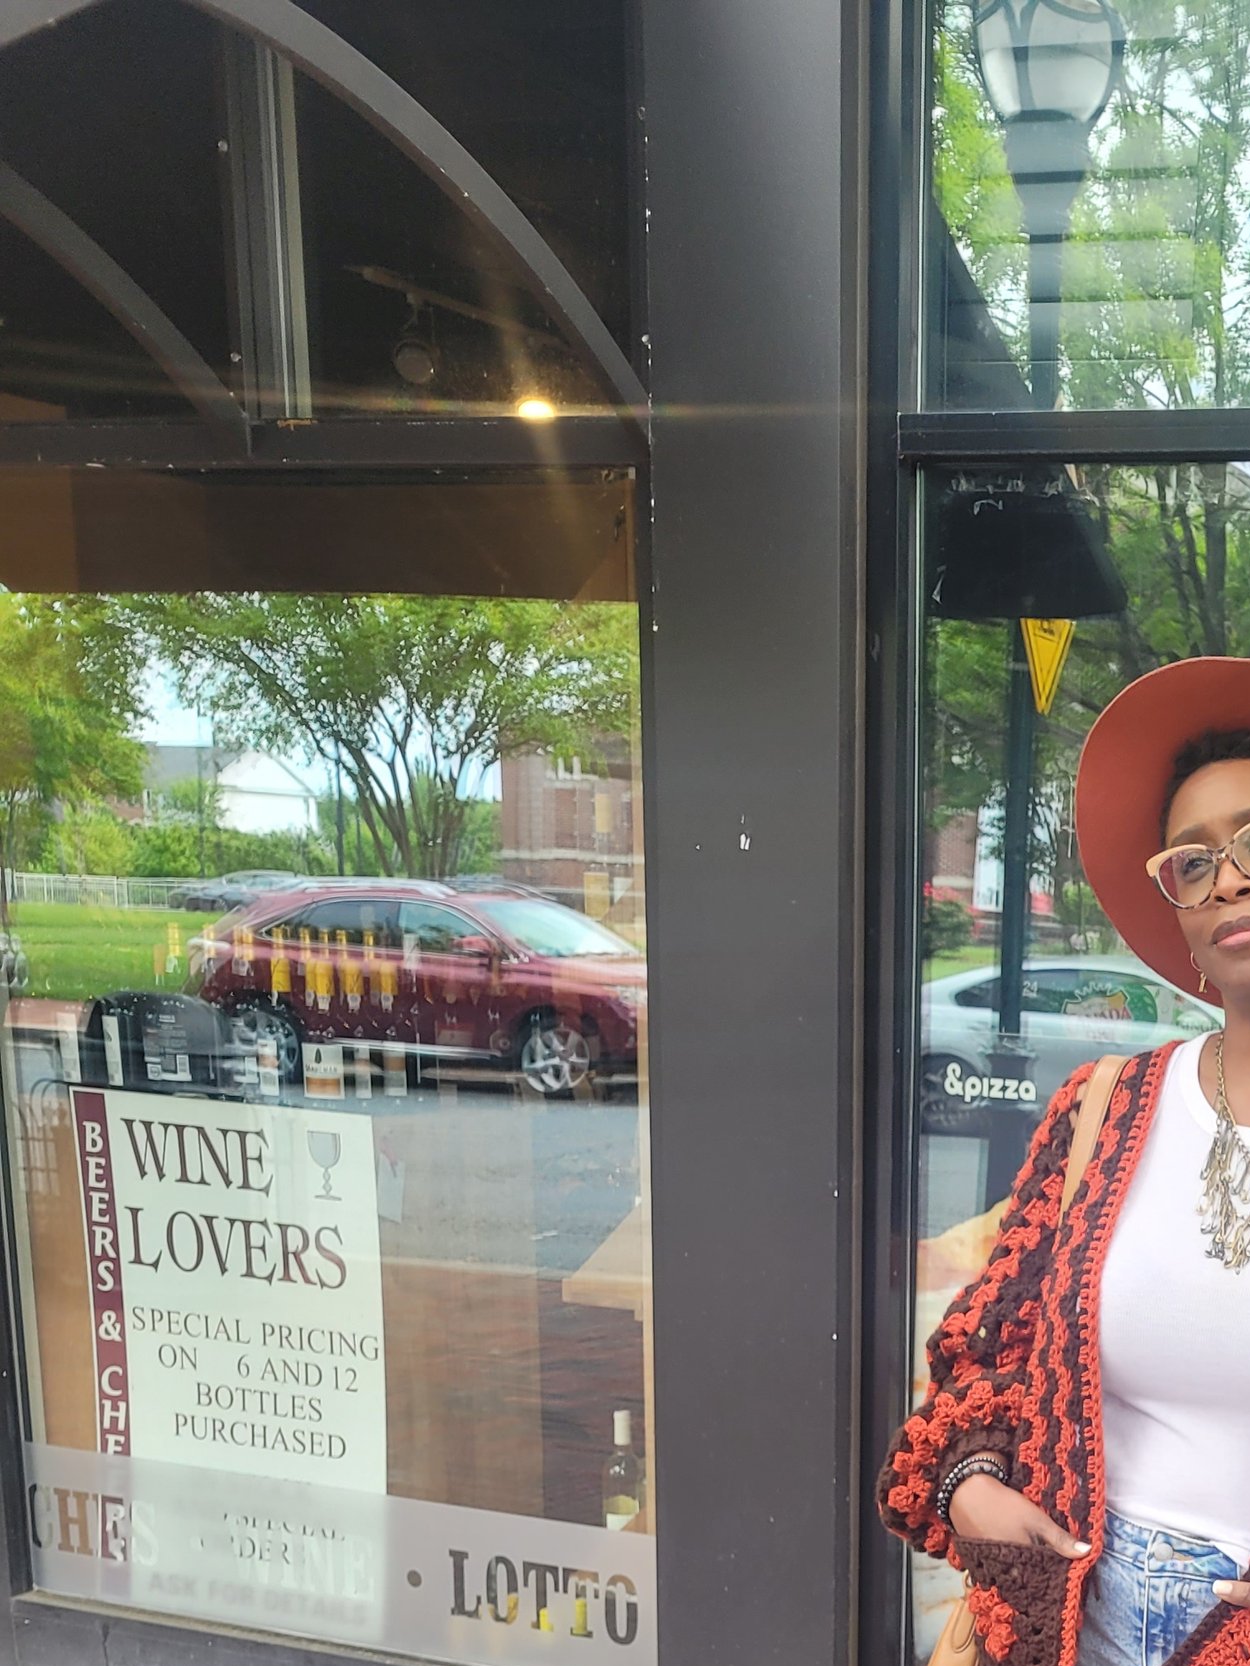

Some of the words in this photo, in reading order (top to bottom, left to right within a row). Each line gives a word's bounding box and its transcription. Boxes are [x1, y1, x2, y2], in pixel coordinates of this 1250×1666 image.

[943, 1061, 1037, 1104] &pizza
[120, 1117, 274, 1198] WINE
[82, 1120, 117, 1292] BEERS
[124, 1205, 347, 1290] LOVERS
[98, 1309, 123, 1343] &
[131, 1305, 251, 1345] SPECIAL
[261, 1321, 379, 1362] PRICING
[158, 1343, 198, 1371] ON
[236, 1353, 250, 1379] 6
[260, 1357, 323, 1388] AND
[332, 1365, 359, 1393] 12
[196, 1381, 323, 1423] BOTTLES
[174, 1412, 347, 1460] PURCHASED
[448, 1548, 639, 1646] LOTTO
